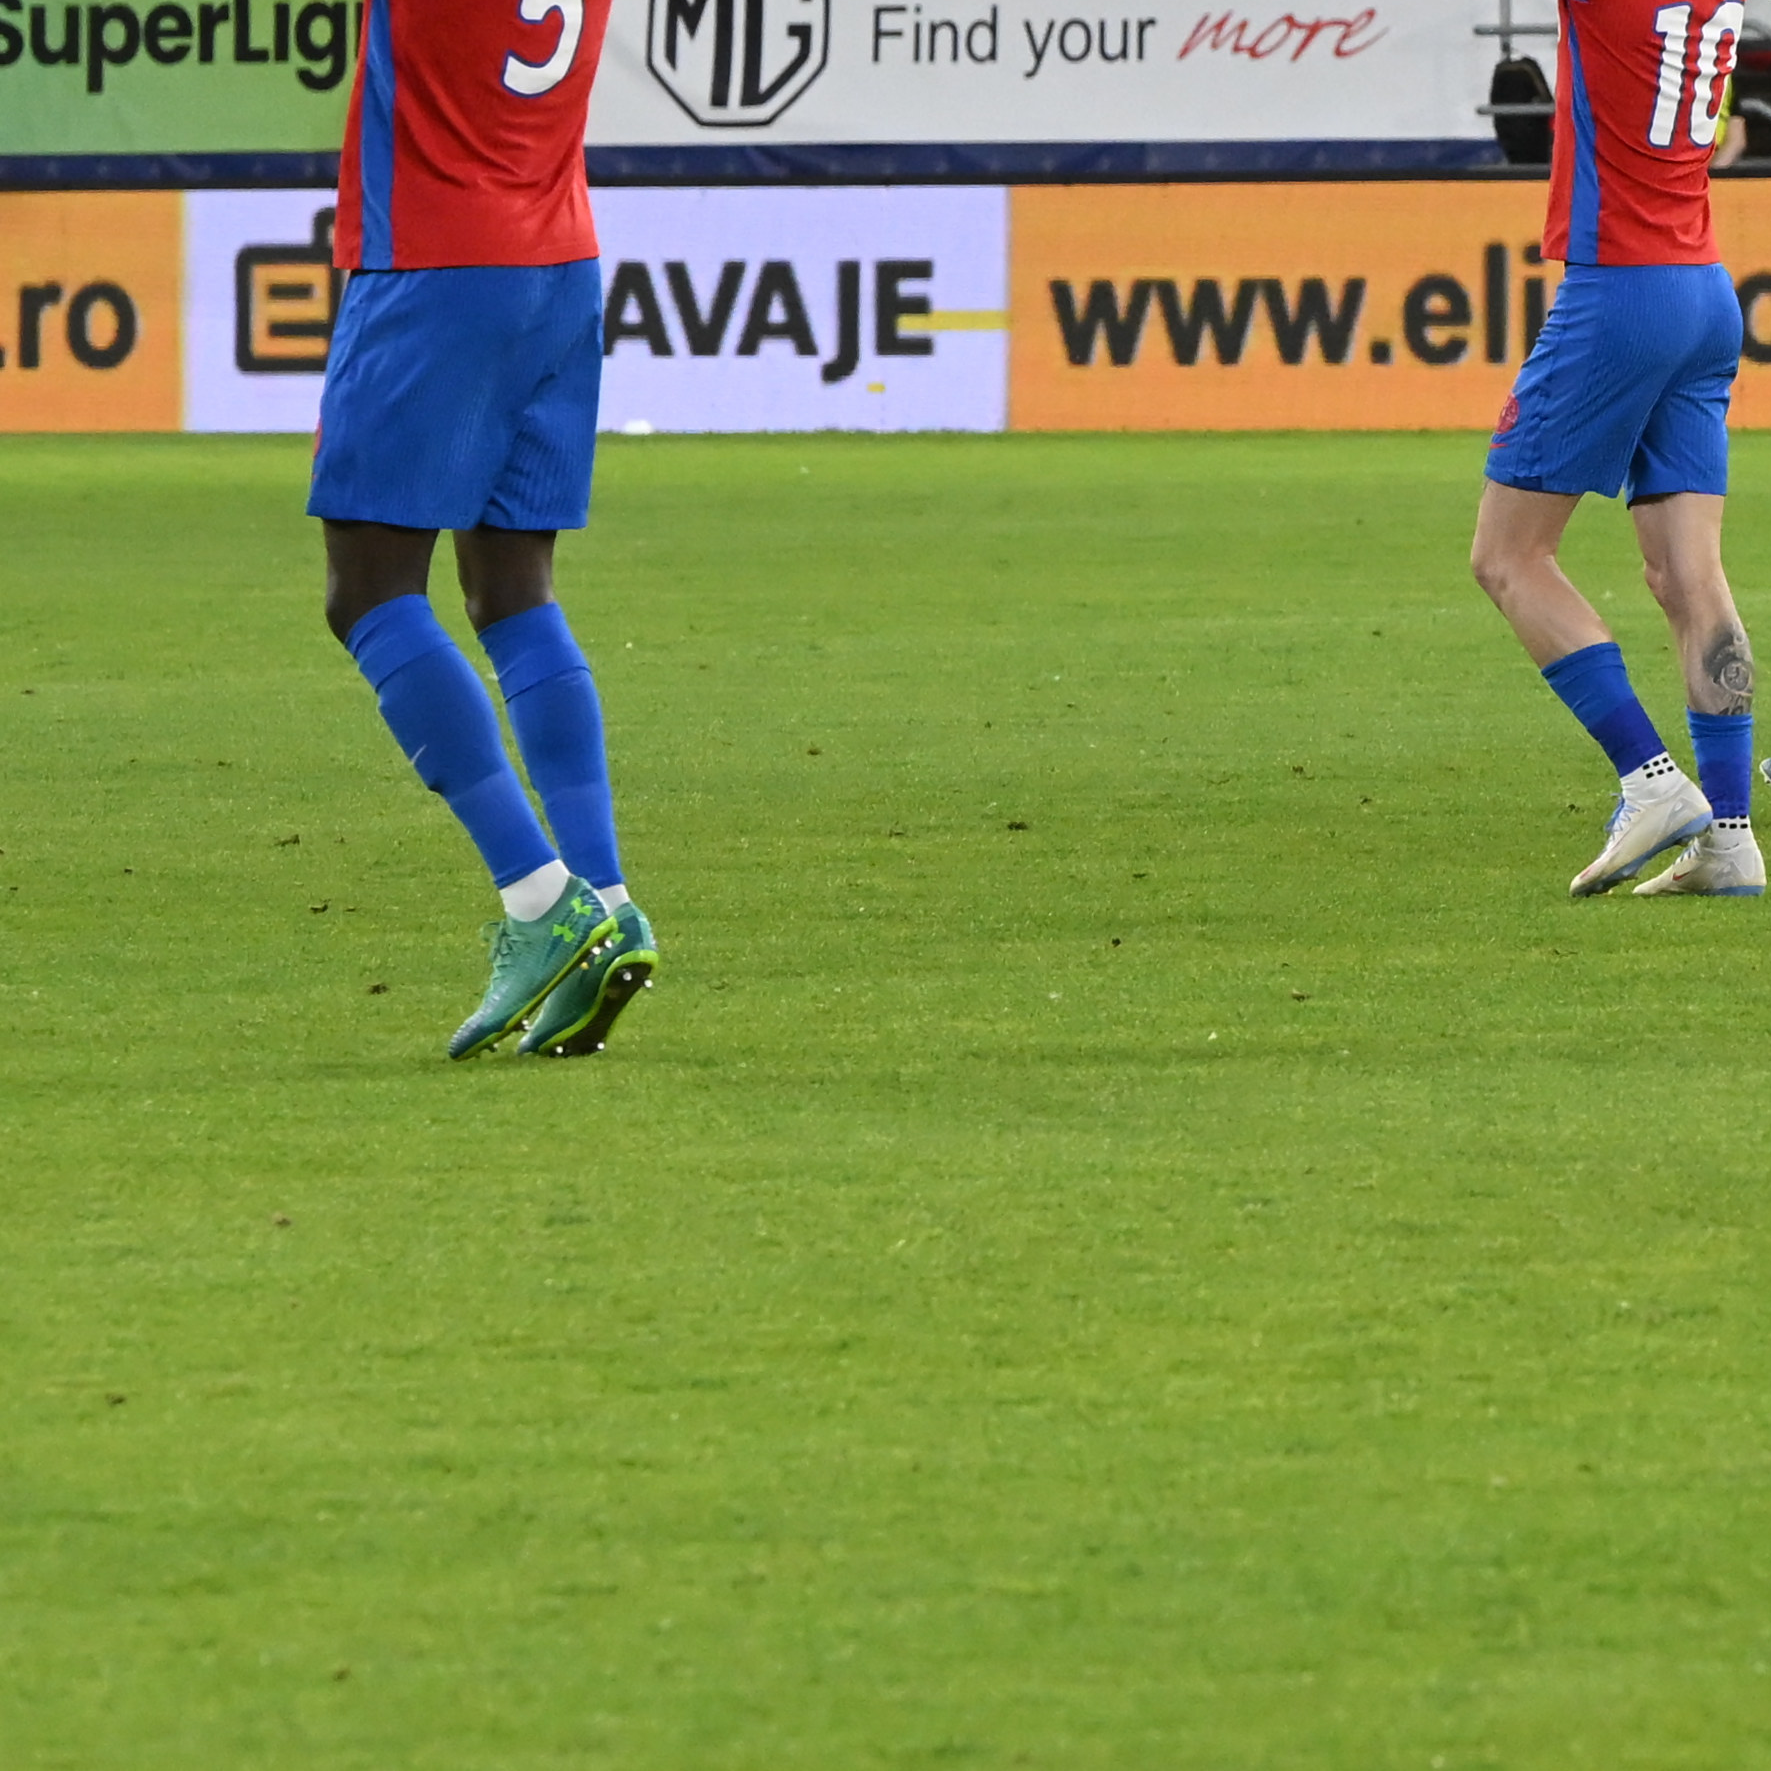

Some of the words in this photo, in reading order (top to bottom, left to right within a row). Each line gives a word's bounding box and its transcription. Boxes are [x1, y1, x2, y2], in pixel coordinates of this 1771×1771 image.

[873, 5, 998, 64] Find
[1023, 16, 1156, 78] your
[1177, 7, 1390, 62] more
[1647, 0, 1746, 150] 10
[603, 259, 934, 383] AVAJE
